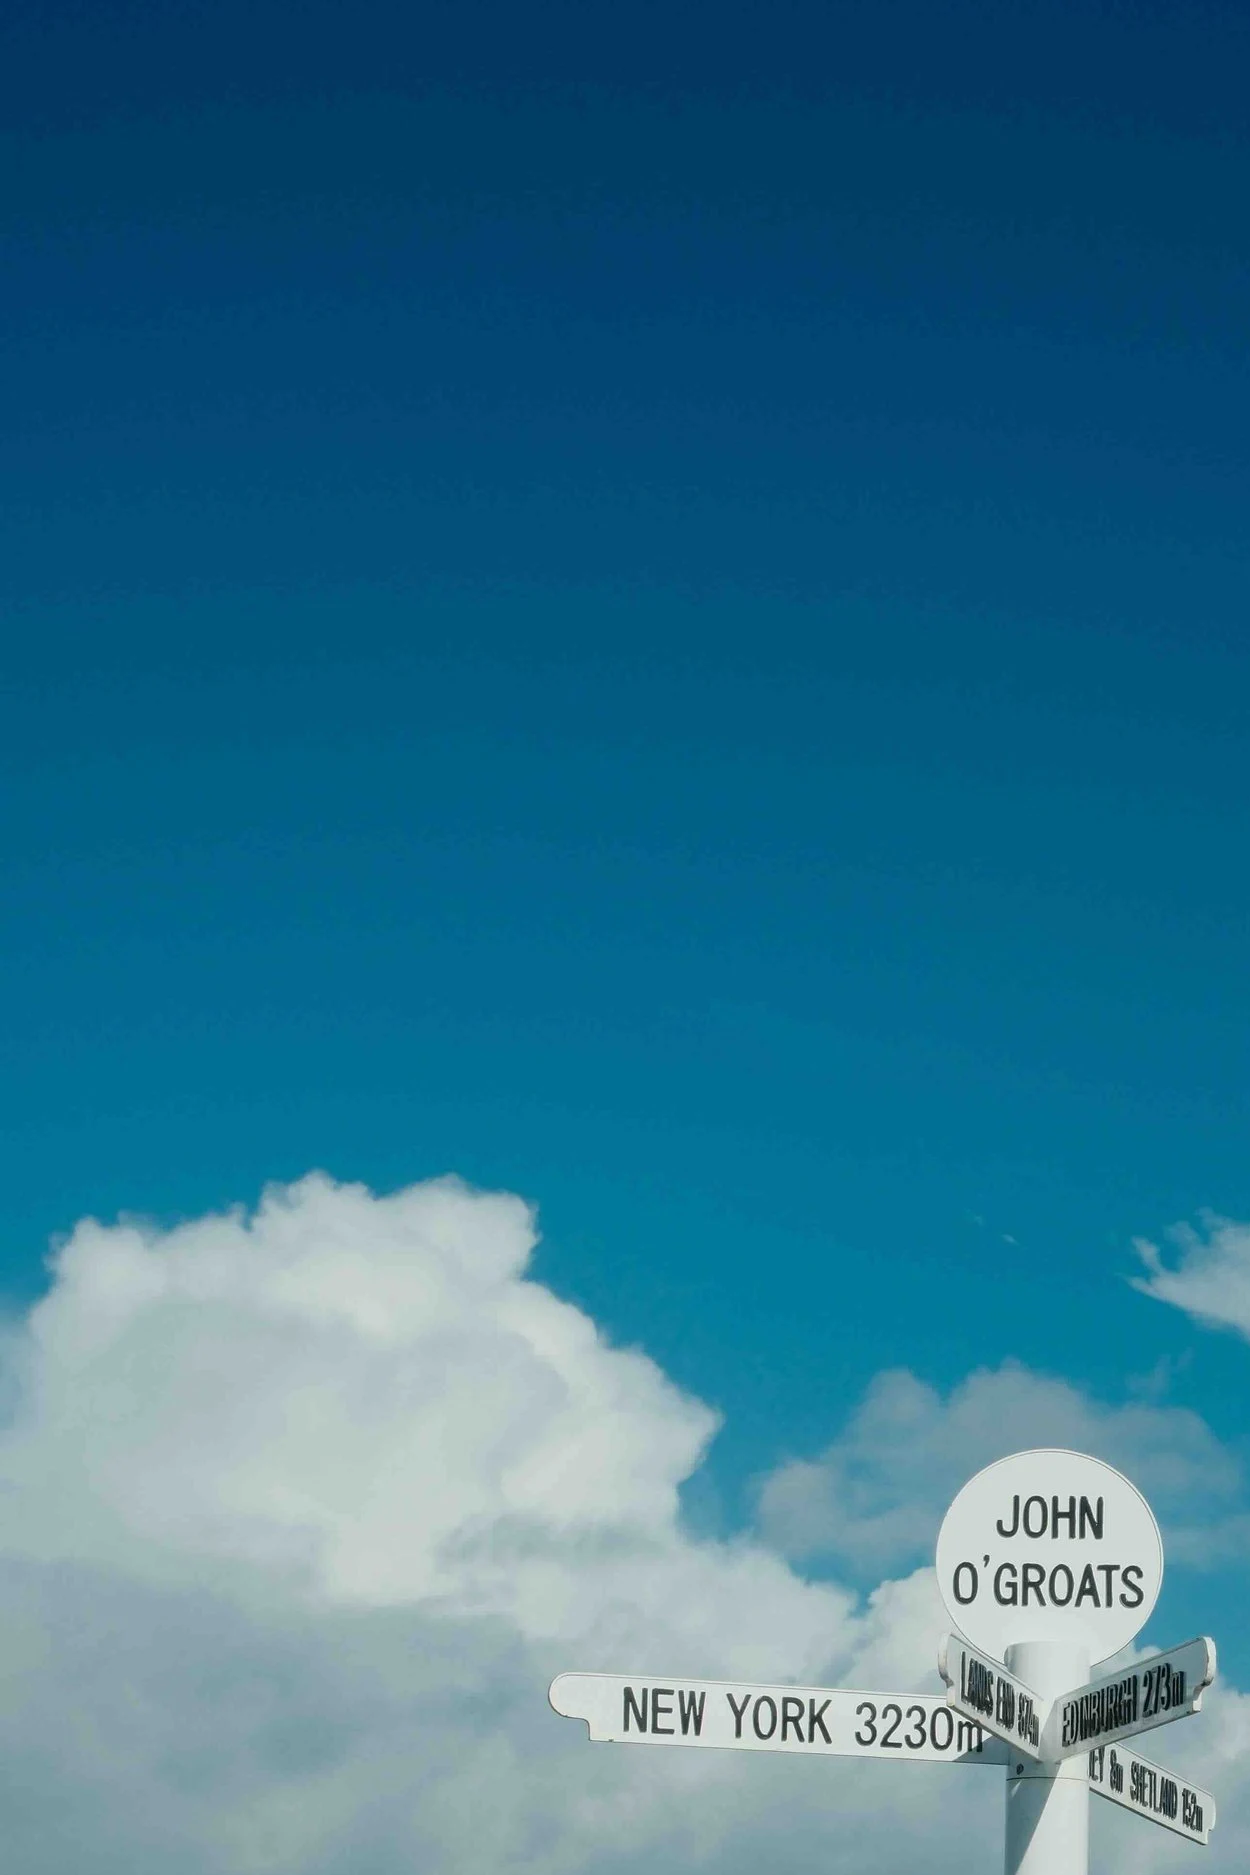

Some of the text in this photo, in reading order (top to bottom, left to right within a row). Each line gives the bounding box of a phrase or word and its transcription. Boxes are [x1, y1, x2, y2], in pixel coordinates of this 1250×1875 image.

[996, 1494, 1104, 1540] JOHN
[953, 1554, 1145, 1609] O'GROATS
[623, 1686, 982, 1753] NEW YORK 3230m
[960, 1651, 1040, 1748] LANDS END 874m
[1061, 1662, 1185, 1747] EDINBURGH 273m
[1109, 1749, 1124, 1794] 8m
[1129, 1760, 1178, 1820] SHETLAND
[1181, 1787, 1203, 1833] 152m
